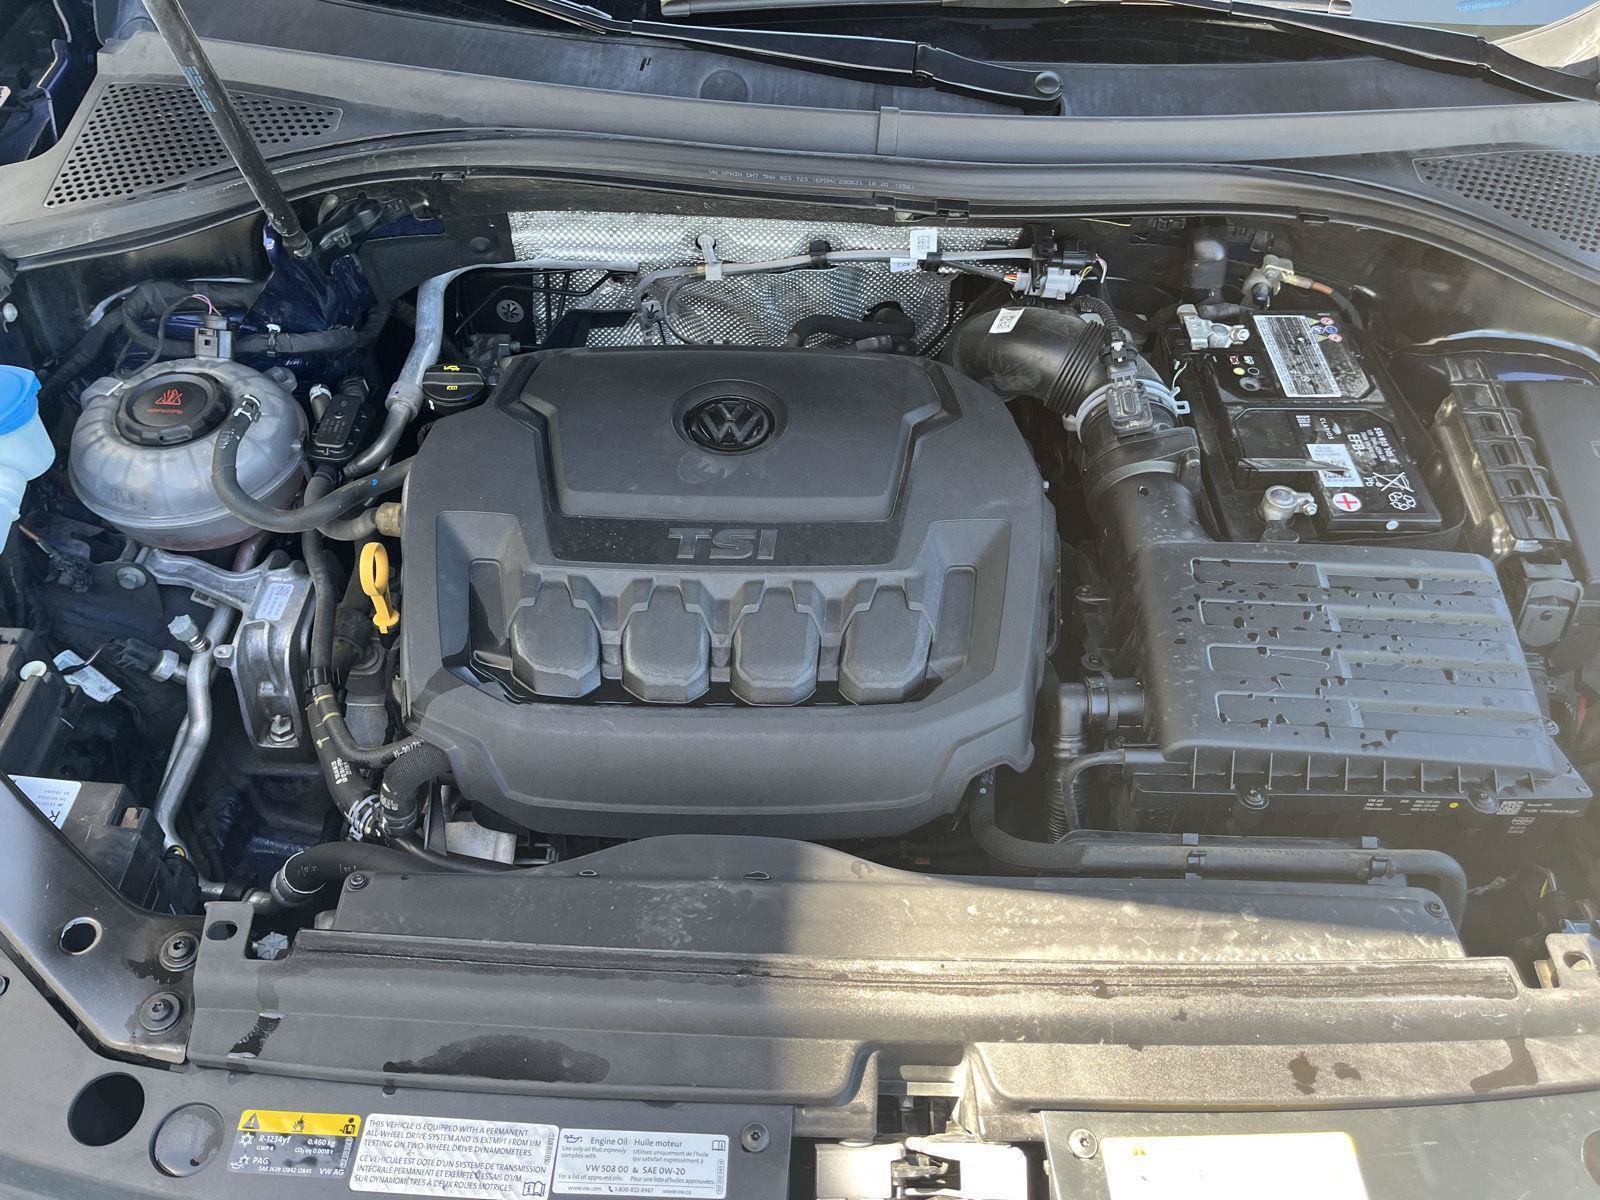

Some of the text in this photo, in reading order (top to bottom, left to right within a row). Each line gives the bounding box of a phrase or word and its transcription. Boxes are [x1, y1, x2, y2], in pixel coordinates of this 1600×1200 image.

[1320, 418, 1334, 440] CLARIOS
[1347, 434, 1366, 456] EFB+
[667, 528, 779, 560] TSI
[386, 1121, 414, 1129] VEHICLE
[423, 1123, 458, 1132] EQUIPPED
[460, 1126, 478, 1134] WITH
[486, 1128, 528, 1136] PERMANENT
[259, 1136, 336, 1148] R-1234yf 0.460 kg
[366, 1130, 404, 1138] ALL-WHEEL
[406, 1132, 426, 1140] DRIVE
[428, 1134, 454, 1142] SYSTEM
[480, 1136, 507, 1144] EXEMPT
[508, 1138, 528, 1146] FROM
[590, 1137, 616, 1146] Engine
[655, 1140, 682, 1148] moteur
[364, 1139, 392, 1148] TESTING
[394, 1140, 405, 1148] ON
[407, 1141, 450, 1151] TWO-WHEEL
[452, 1144, 473, 1152] DRIVE
[253, 1156, 270, 1164] PAG
[360, 1154, 368, 1162] CE
[436, 1159, 454, 1168] D'UN
[485, 1162, 494, 1170] DE
[496, 1163, 546, 1173] TRANSMISSION
[332, 1168, 344, 1176] AG
[394, 1166, 434, 1176] PERMANENT
[586, 1164, 600, 1172] VW
[642, 1166, 658, 1174] SAE
[660, 1167, 686, 1176] 0W-20
[354, 1174, 368, 1182] SUR
[434, 1180, 453, 1188] DEUX
